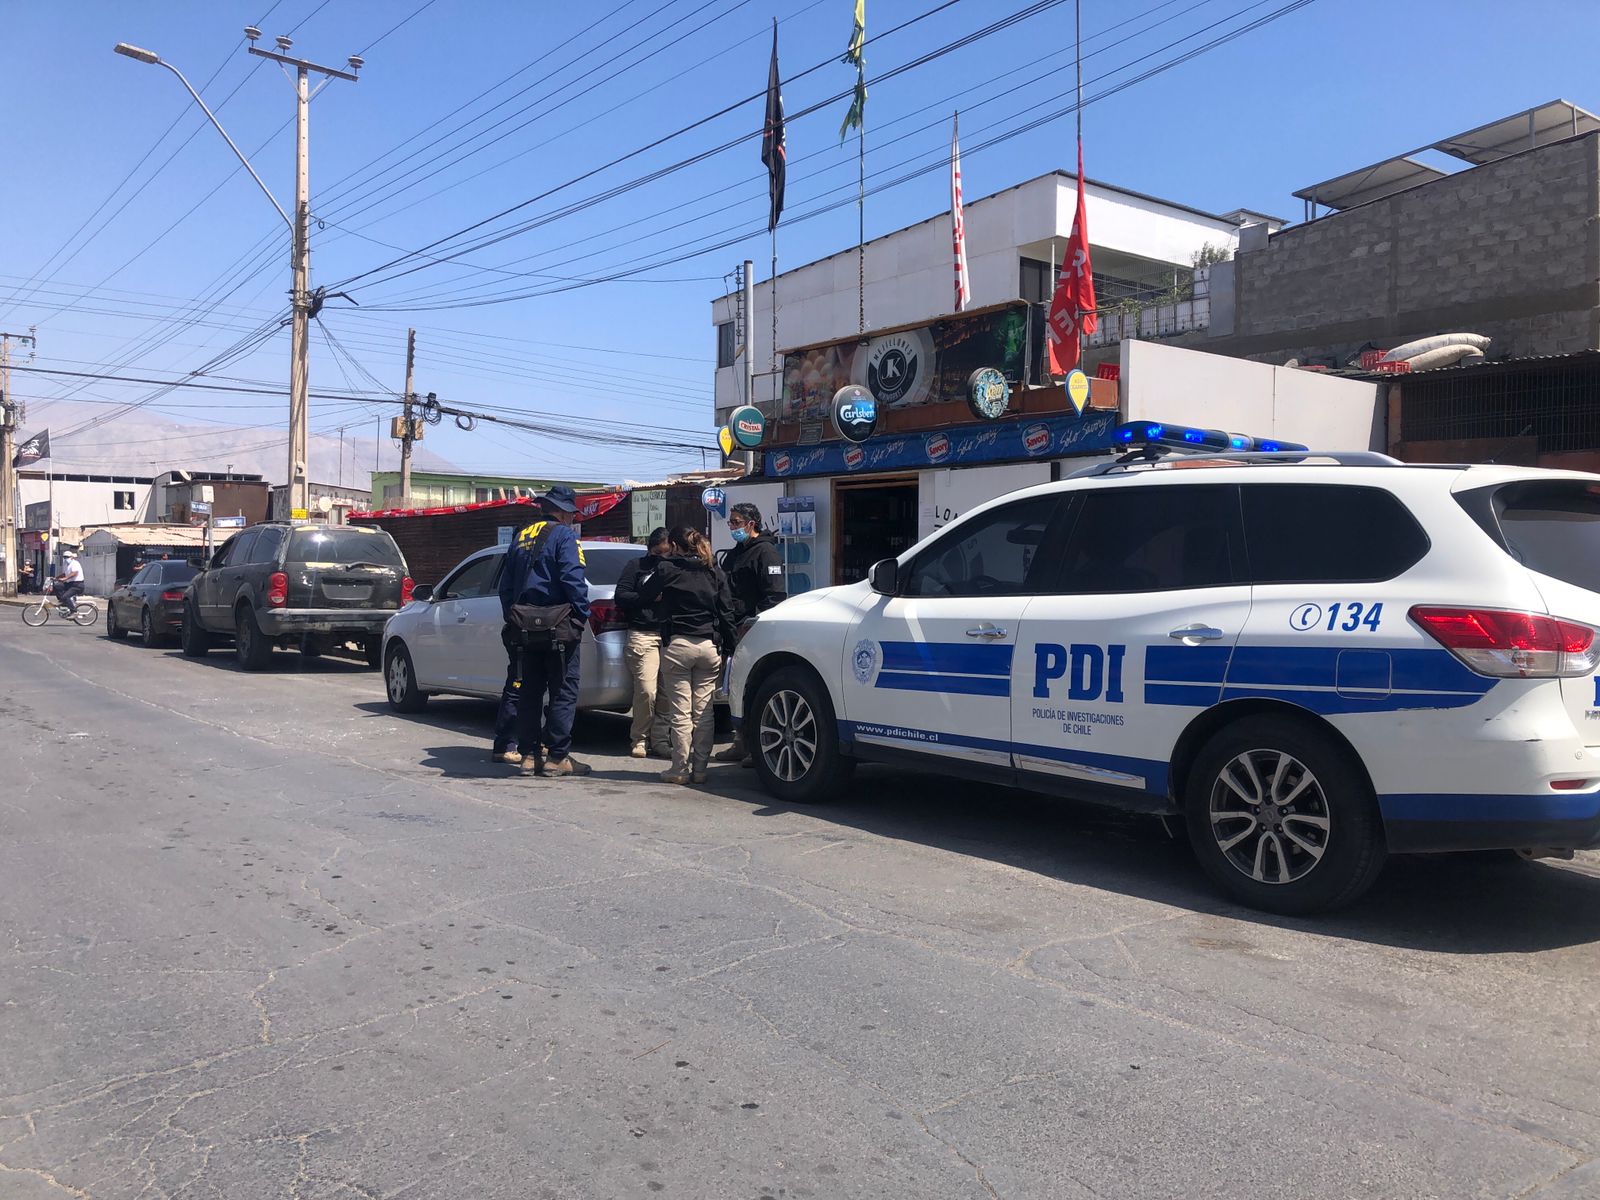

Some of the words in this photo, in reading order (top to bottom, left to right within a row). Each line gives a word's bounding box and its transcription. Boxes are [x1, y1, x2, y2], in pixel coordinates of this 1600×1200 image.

[873, 337, 912, 360] MEJILLONES
[740, 422, 761, 432] CRISTAL
[928, 442, 948, 456] Savory
[1026, 433, 1048, 448] Savory
[518, 521, 548, 542] PD
[1327, 602, 1384, 632] 134
[1033, 643, 1126, 703] PDI
[1032, 706, 1057, 720] POLICÍA
[1057, 710, 1067, 721] DE
[1067, 711, 1125, 727] INVESTIGACIONES
[856, 724, 939, 742] www.pdichile.cl
[1062, 723, 1072, 734] DE
[1072, 724, 1092, 736] CHILE
